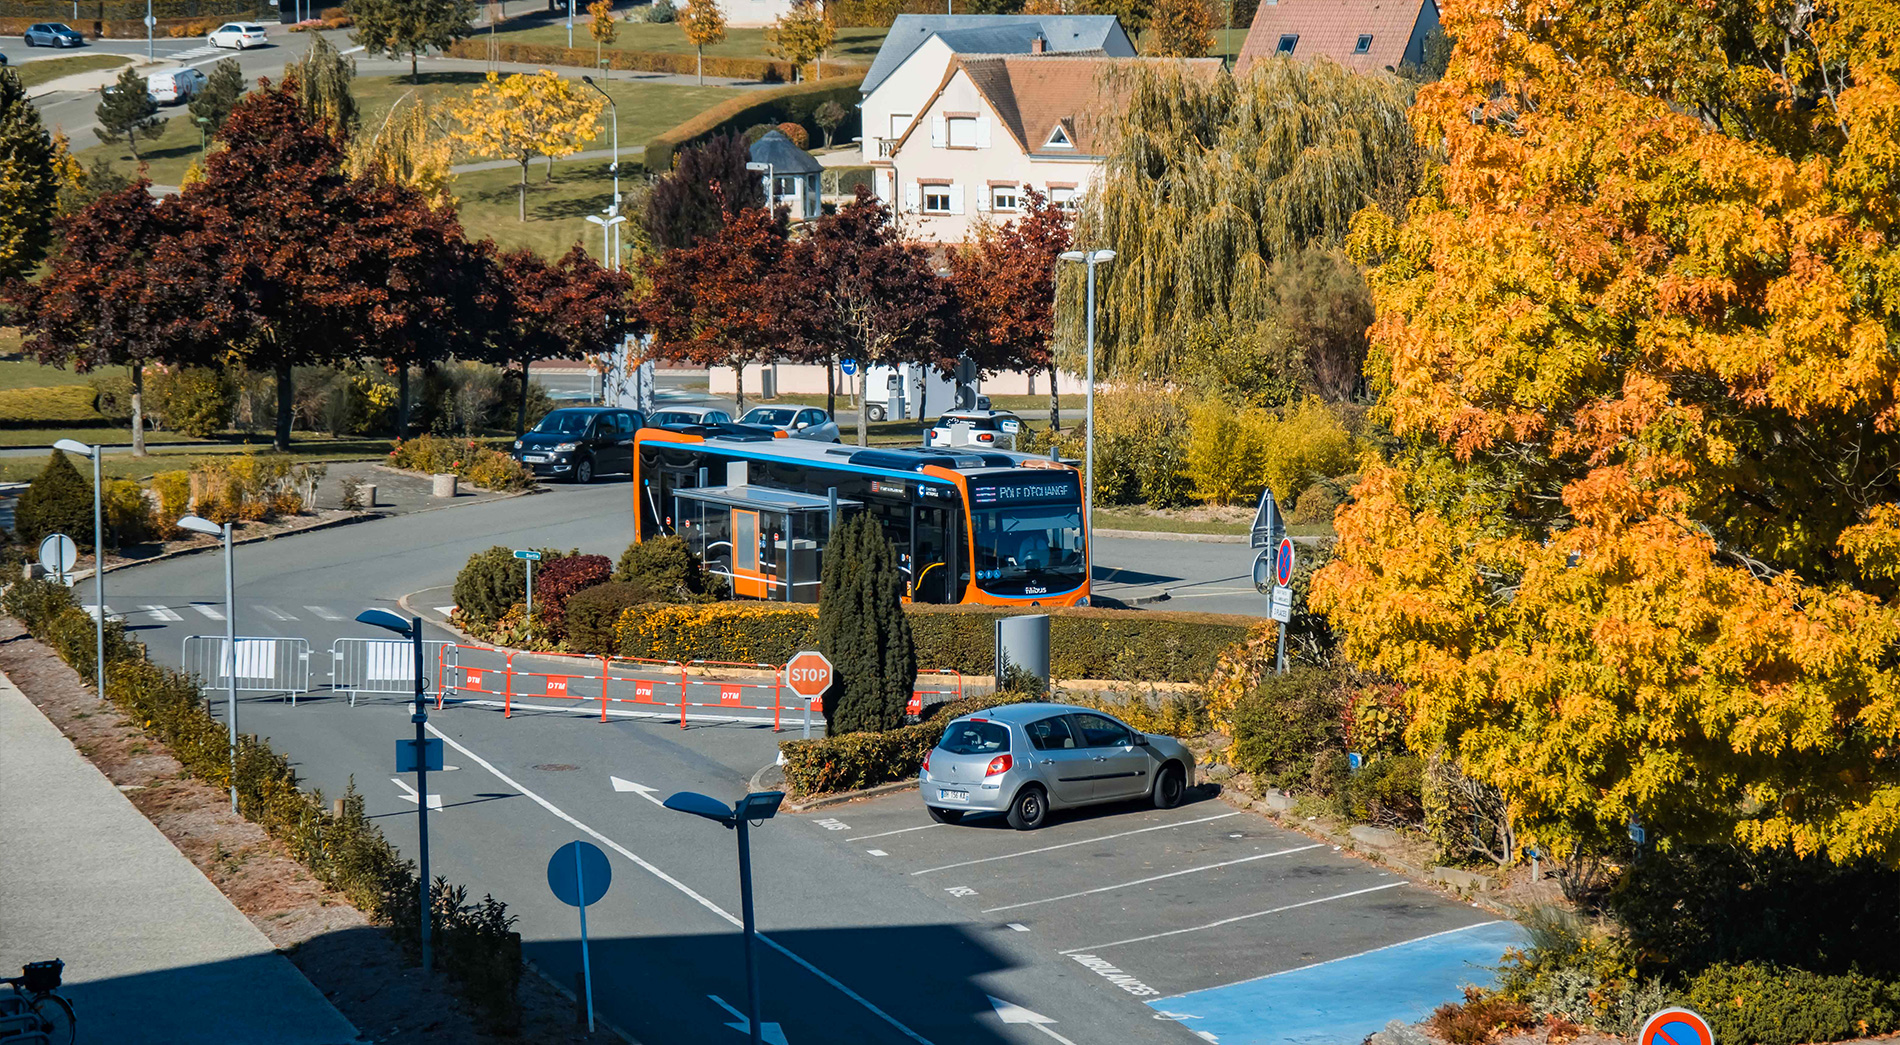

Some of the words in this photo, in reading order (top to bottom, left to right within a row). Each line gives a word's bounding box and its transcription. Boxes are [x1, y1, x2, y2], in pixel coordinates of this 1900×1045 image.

[791, 668, 828, 682] STOP
[467, 676, 481, 684] DTM
[547, 682, 566, 690] DTM
[636, 688, 652, 696] DTM
[1067, 954, 1160, 995] AMBULANCES
